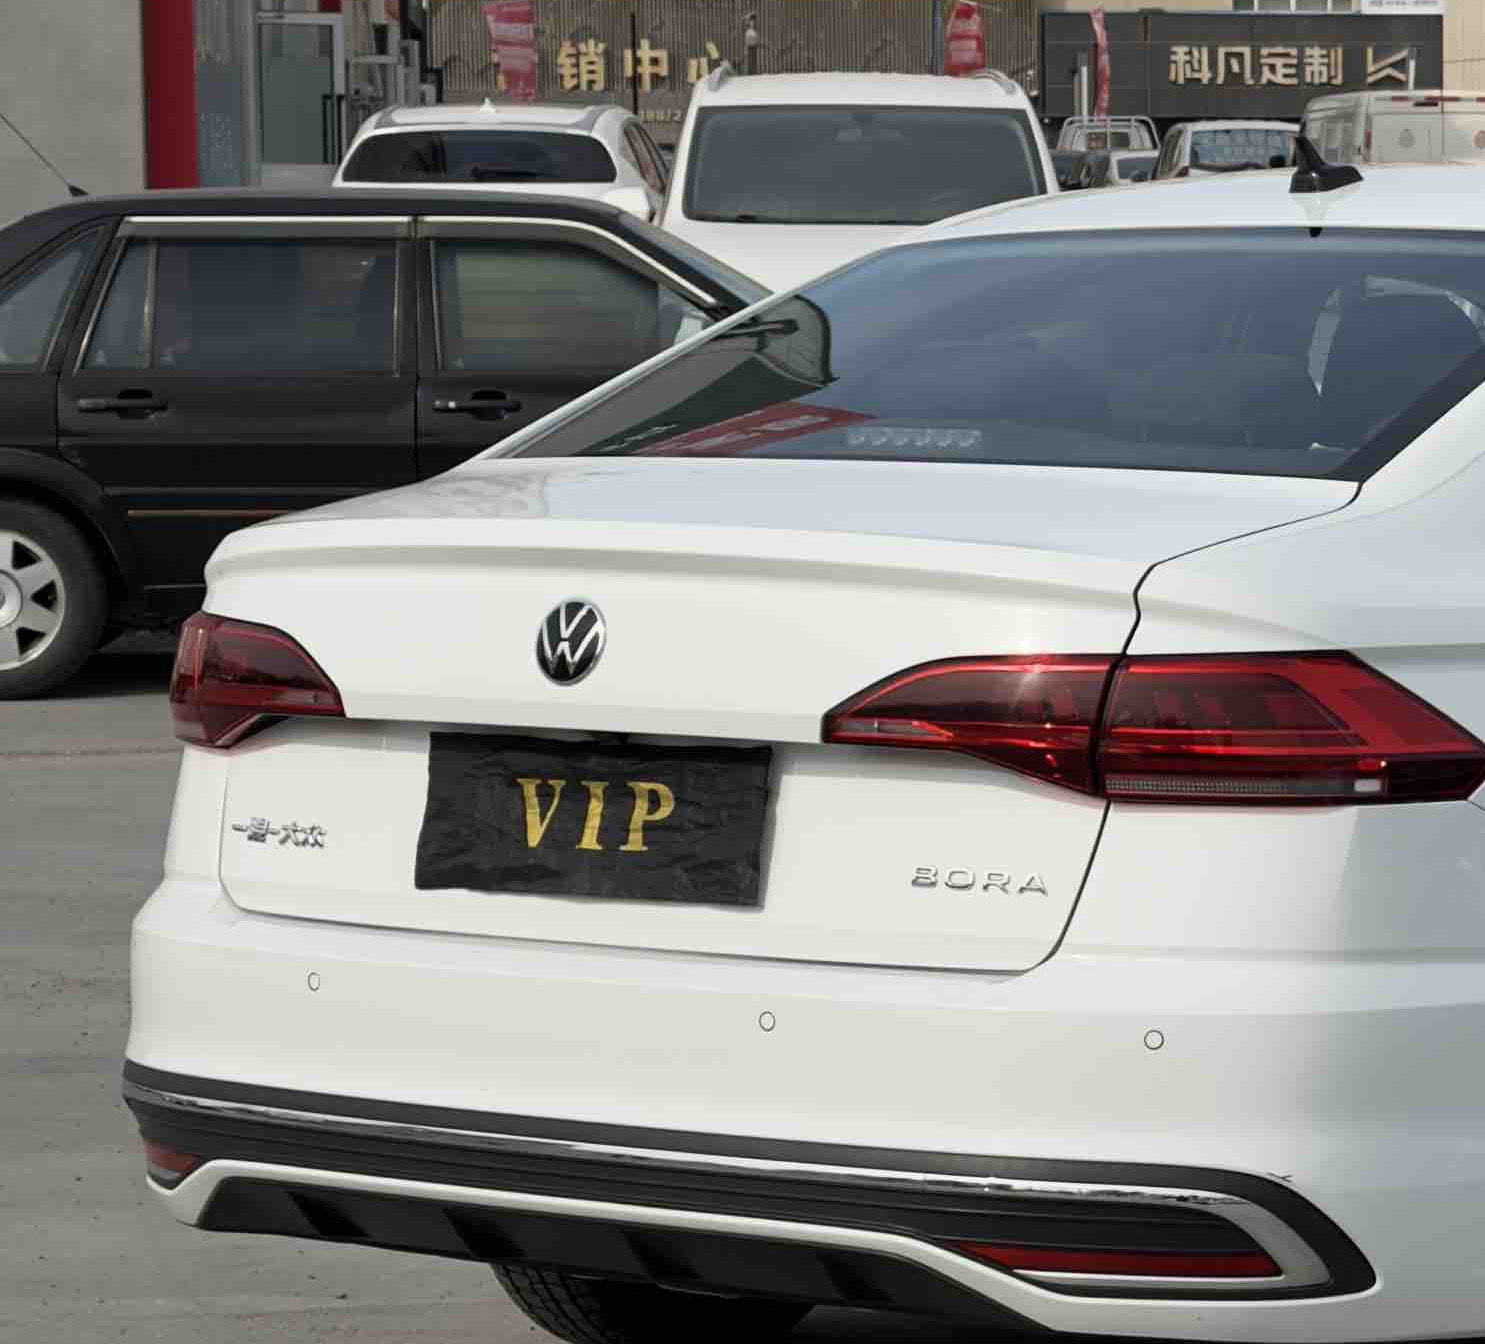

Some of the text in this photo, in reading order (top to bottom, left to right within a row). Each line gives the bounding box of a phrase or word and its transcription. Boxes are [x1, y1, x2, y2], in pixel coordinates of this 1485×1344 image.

[1168, 45, 1344, 86] 科凡定制
[515, 777, 676, 853] VIP
[911, 865, 1048, 897] BORA
